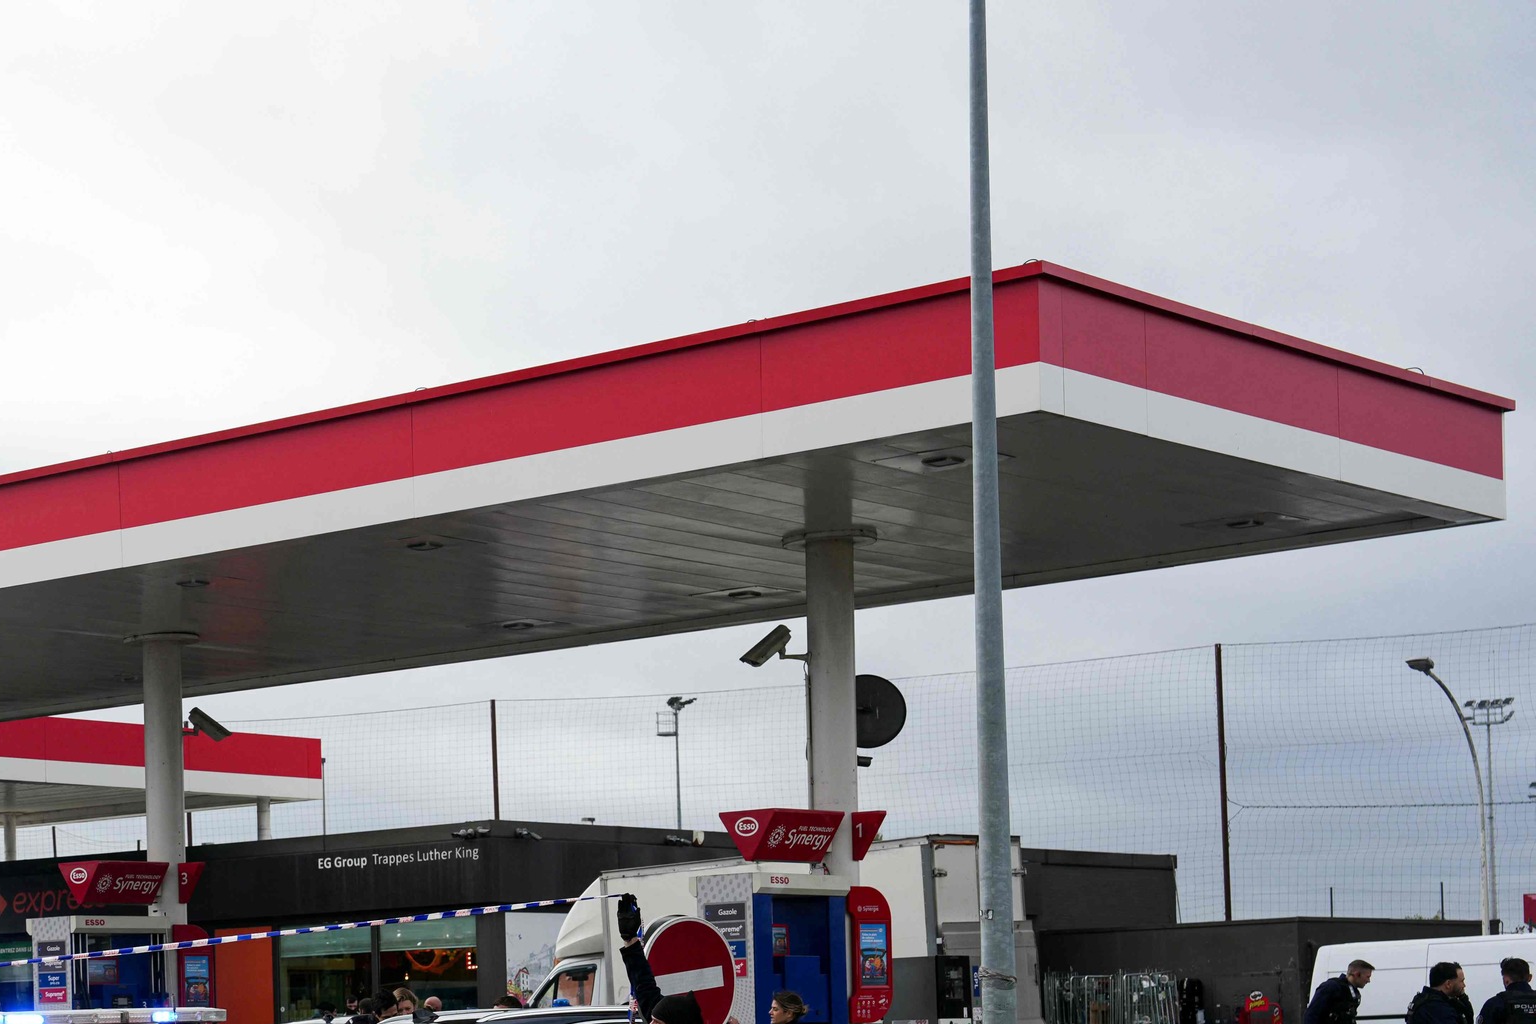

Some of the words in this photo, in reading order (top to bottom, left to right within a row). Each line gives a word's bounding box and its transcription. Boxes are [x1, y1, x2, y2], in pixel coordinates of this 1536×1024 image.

[738, 822, 756, 831] Esso
[855, 823, 863, 838] 1
[784, 829, 831, 851] Synergy
[317, 857, 332, 870] EG
[334, 856, 368, 869] Group
[372, 853, 415, 867] Trappes
[417, 848, 453, 862] Luther
[455, 846, 480, 861] King
[73, 871, 86, 880] Esso
[181, 872, 188, 885] 3
[770, 876, 790, 885] ESSO
[113, 877, 159, 895] Synergy
[717, 907, 738, 917] Gazole
